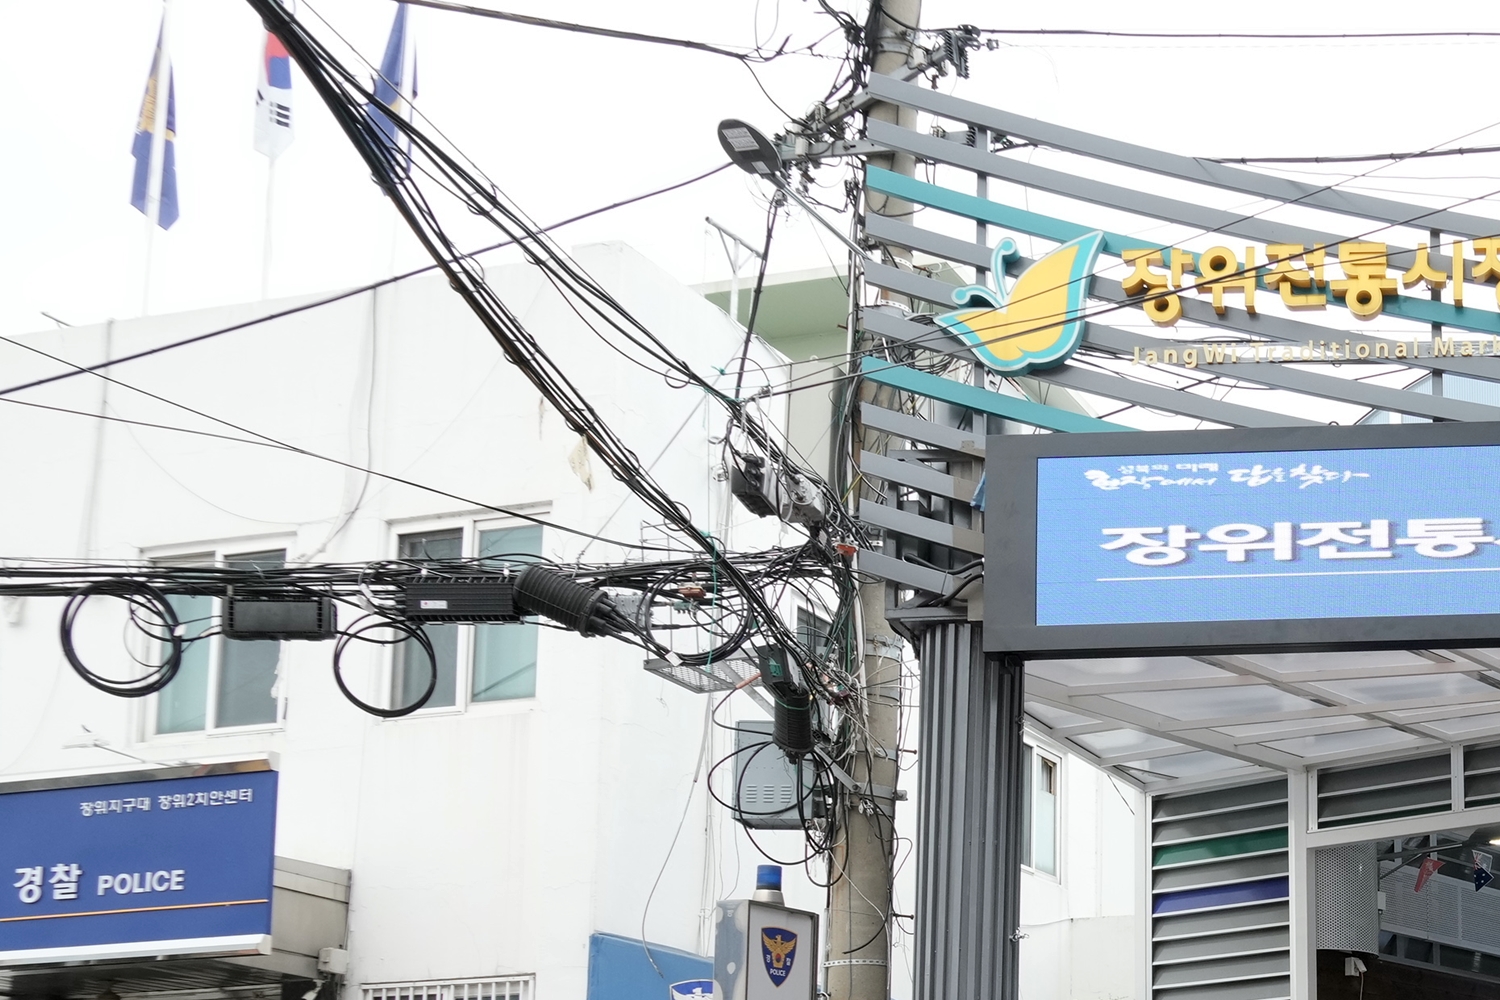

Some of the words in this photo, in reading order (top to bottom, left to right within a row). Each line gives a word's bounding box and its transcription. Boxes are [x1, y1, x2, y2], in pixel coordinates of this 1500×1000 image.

[1132, 343, 1238, 369] JangWi
[1250, 338, 1420, 363] Traditional
[80, 797, 151, 817] 장위지구대
[158, 788, 253, 810] 장위2치안센터
[13, 863, 83, 904] 경찰
[97, 869, 185, 896] POLICE
[769, 967, 786, 978] POLICE
